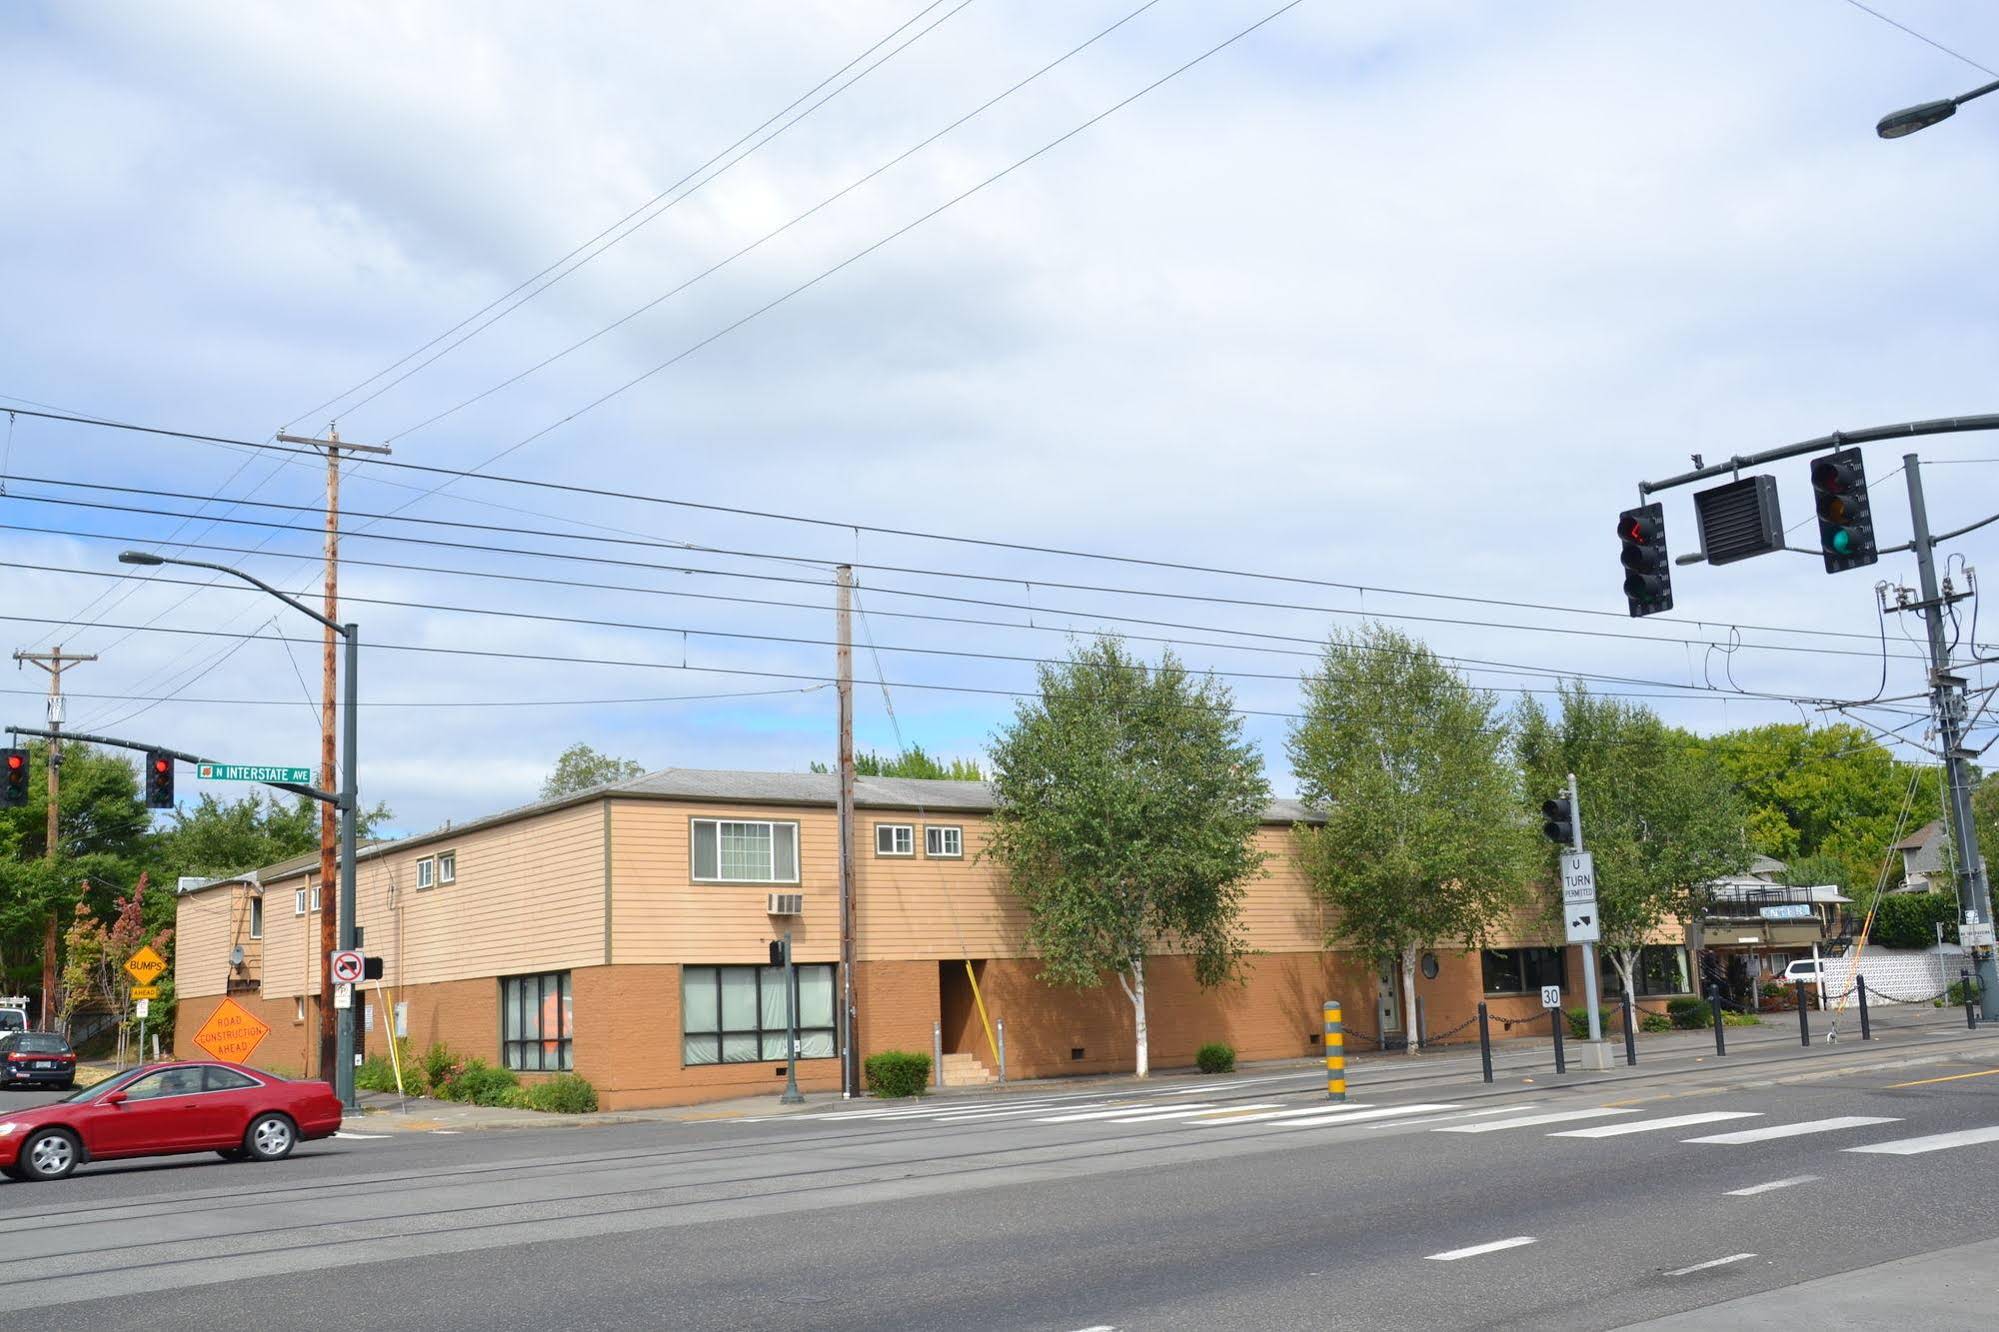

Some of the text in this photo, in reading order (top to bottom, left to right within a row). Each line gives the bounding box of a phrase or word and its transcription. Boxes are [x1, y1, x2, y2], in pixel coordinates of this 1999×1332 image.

[216, 767, 309, 781] N INTERSTATE AVE
[1572, 859, 1580, 870] U
[1565, 874, 1591, 887] TURN
[1566, 888, 1593, 897] PERMITTED
[130, 960, 162, 971] BUMPS
[1543, 989, 1559, 1004] 30
[217, 1016, 242, 1028] ROAD
[200, 1027, 262, 1043] CONSTRUCTION
[218, 1042, 248, 1055] AHEAD
